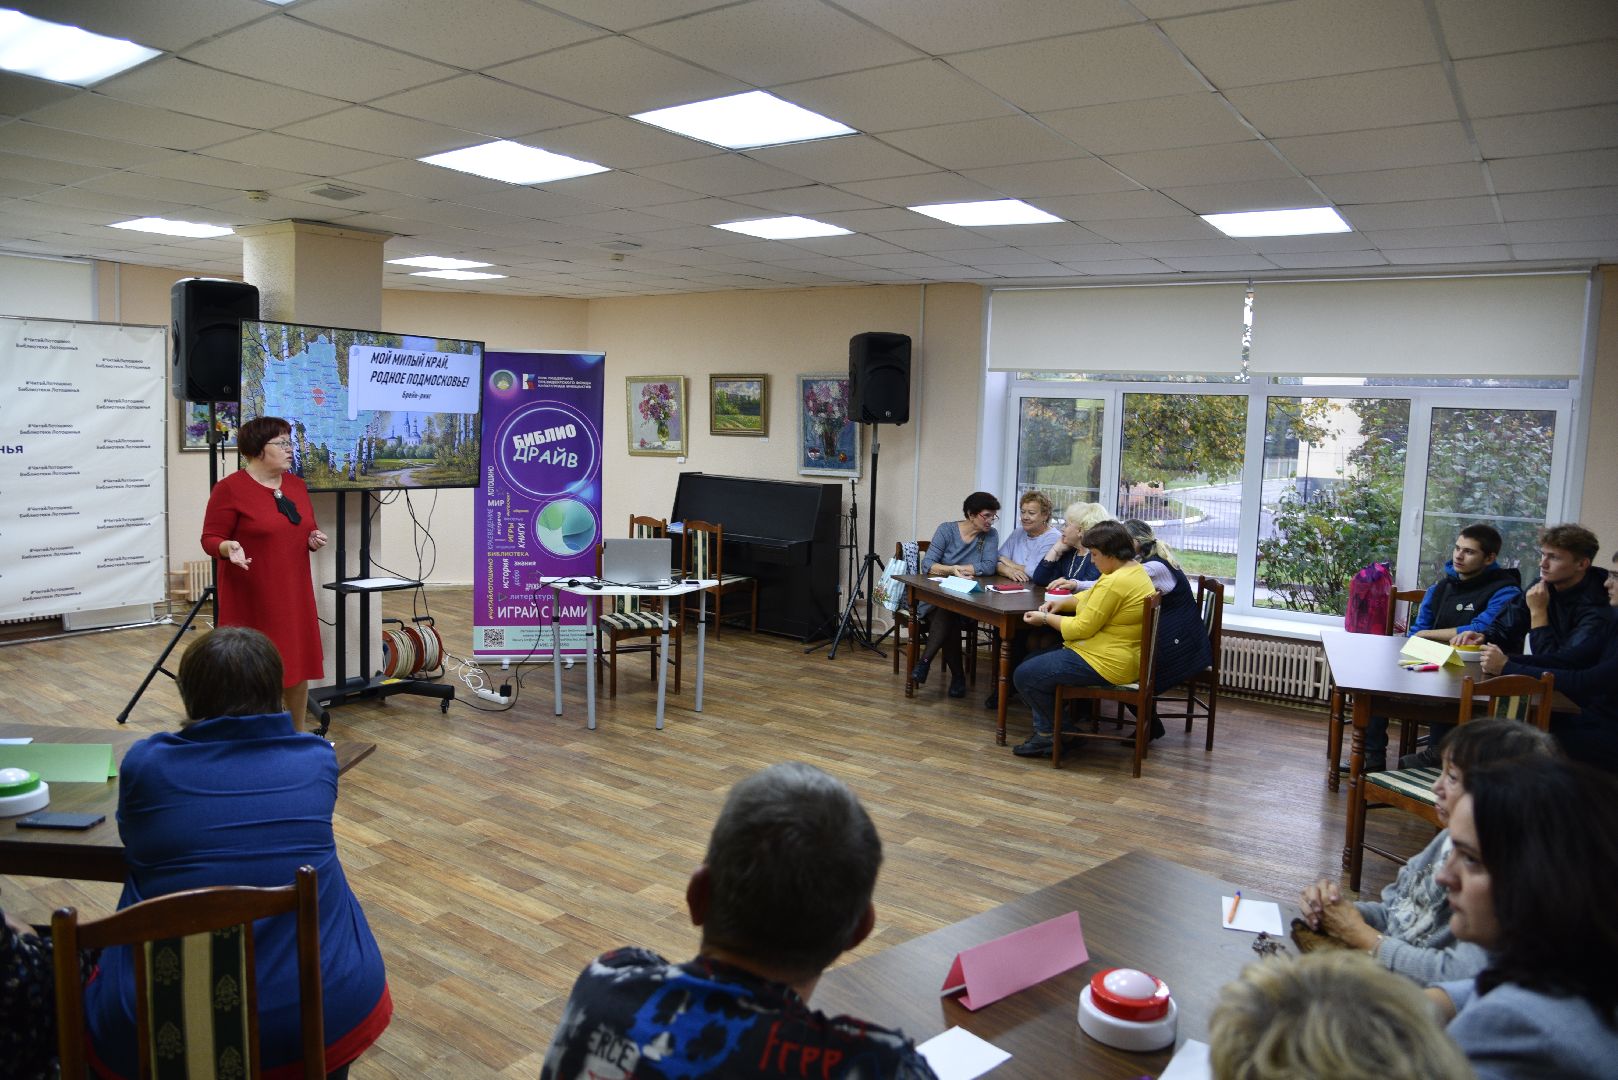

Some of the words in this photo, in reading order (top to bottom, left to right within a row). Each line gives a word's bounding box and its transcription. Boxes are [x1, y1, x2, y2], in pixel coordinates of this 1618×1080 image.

[370, 350, 392, 364] МОЙ
[392, 353, 426, 367] МИЛЫЙ
[425, 355, 448, 369] КРАЙ,
[370, 371, 406, 385] РОДНОЕ
[406, 373, 470, 387] ПОДМОСКОВЬЕ!
[513, 424, 576, 449] БИБЛИО
[513, 446, 578, 468] ДРАЙВ
[498, 602, 538, 618] ИГРАЙ
[542, 606, 549, 618] С
[558, 606, 588, 618] АМИ
